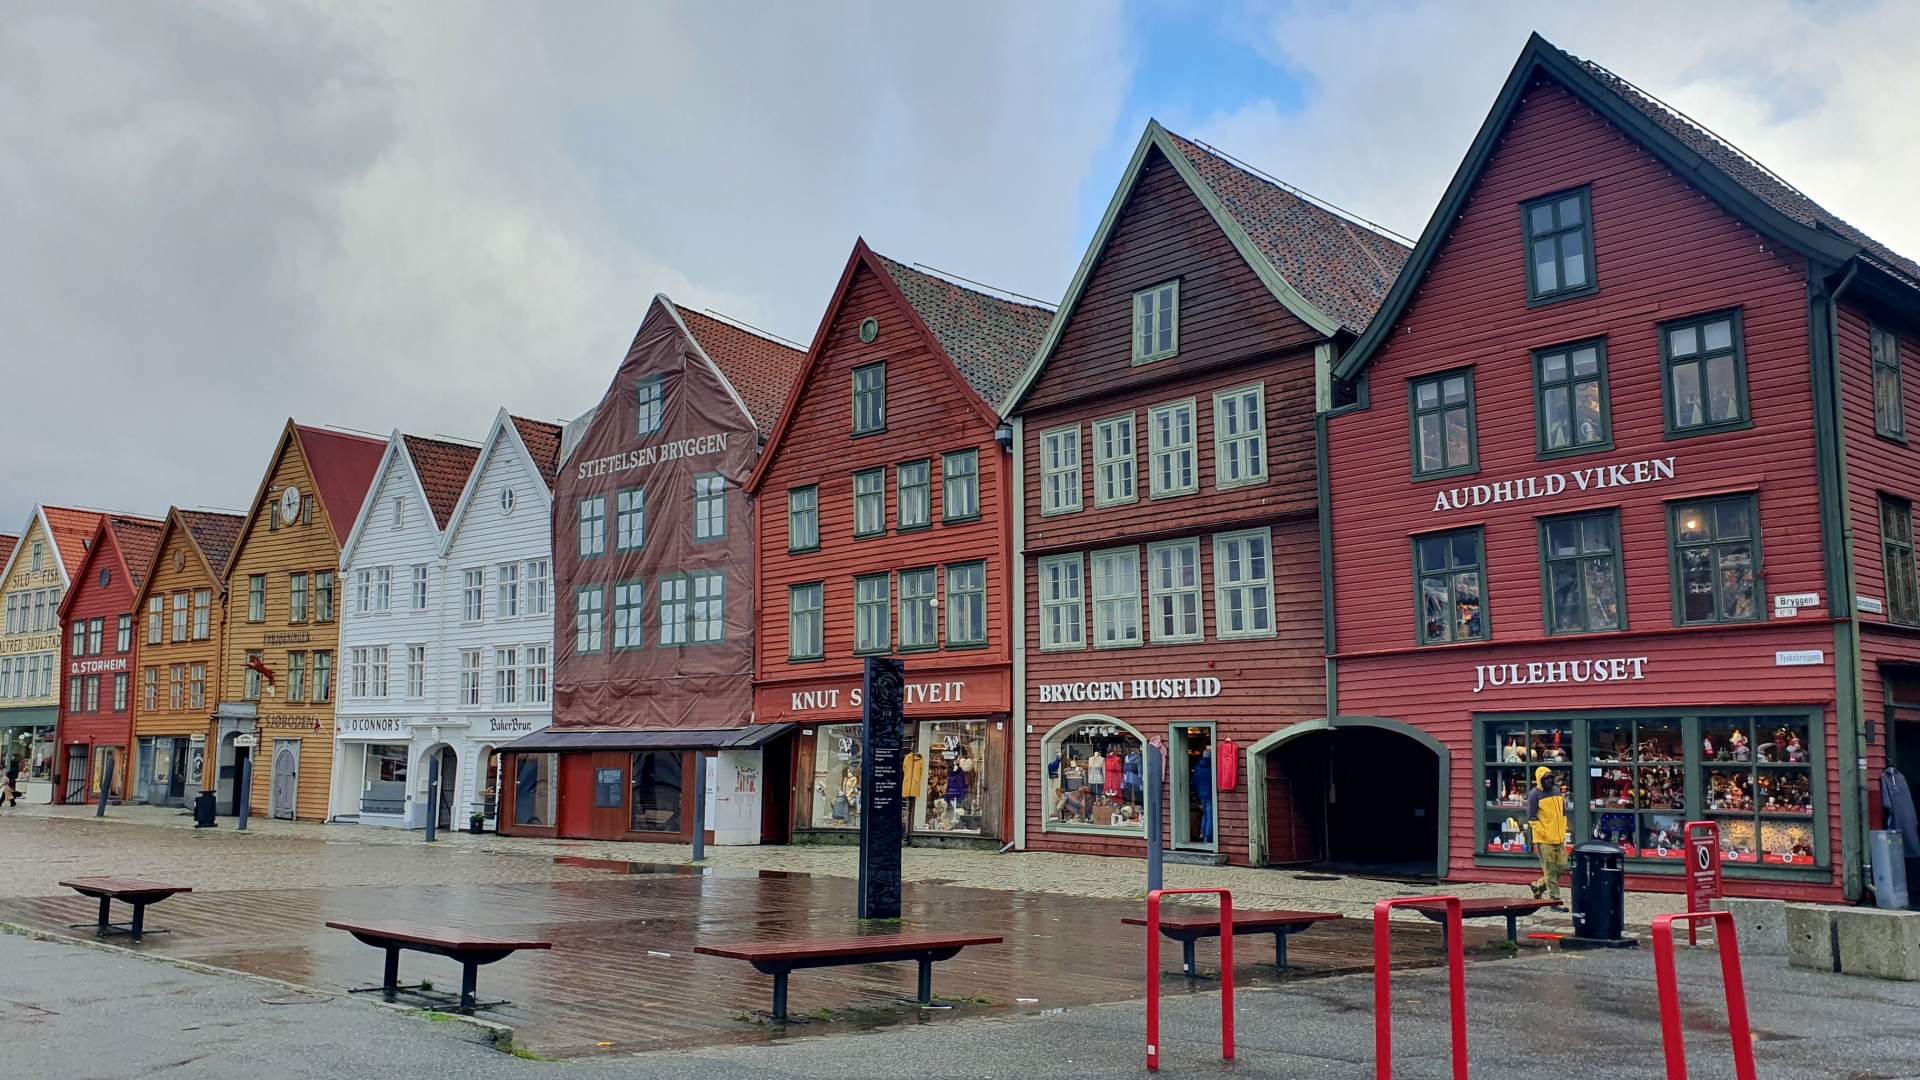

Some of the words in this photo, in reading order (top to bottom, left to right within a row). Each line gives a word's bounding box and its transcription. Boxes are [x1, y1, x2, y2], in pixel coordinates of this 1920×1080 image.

[578, 446, 657, 479] STIFTELSEN
[659, 432, 729, 462] BRYGGEN
[1432, 473, 1566, 512] AUDHILD
[1571, 456, 1676, 491] VIKEN
[1780, 597, 1813, 607] Bryggen
[1473, 656, 1648, 693] JULEHUSET
[791, 689, 840, 711] KNUT
[1039, 681, 1124, 703] BRYGGEN
[1131, 677, 1221, 699] HUSFLID
[352, 719, 400, 731] O'CONNOR'S
